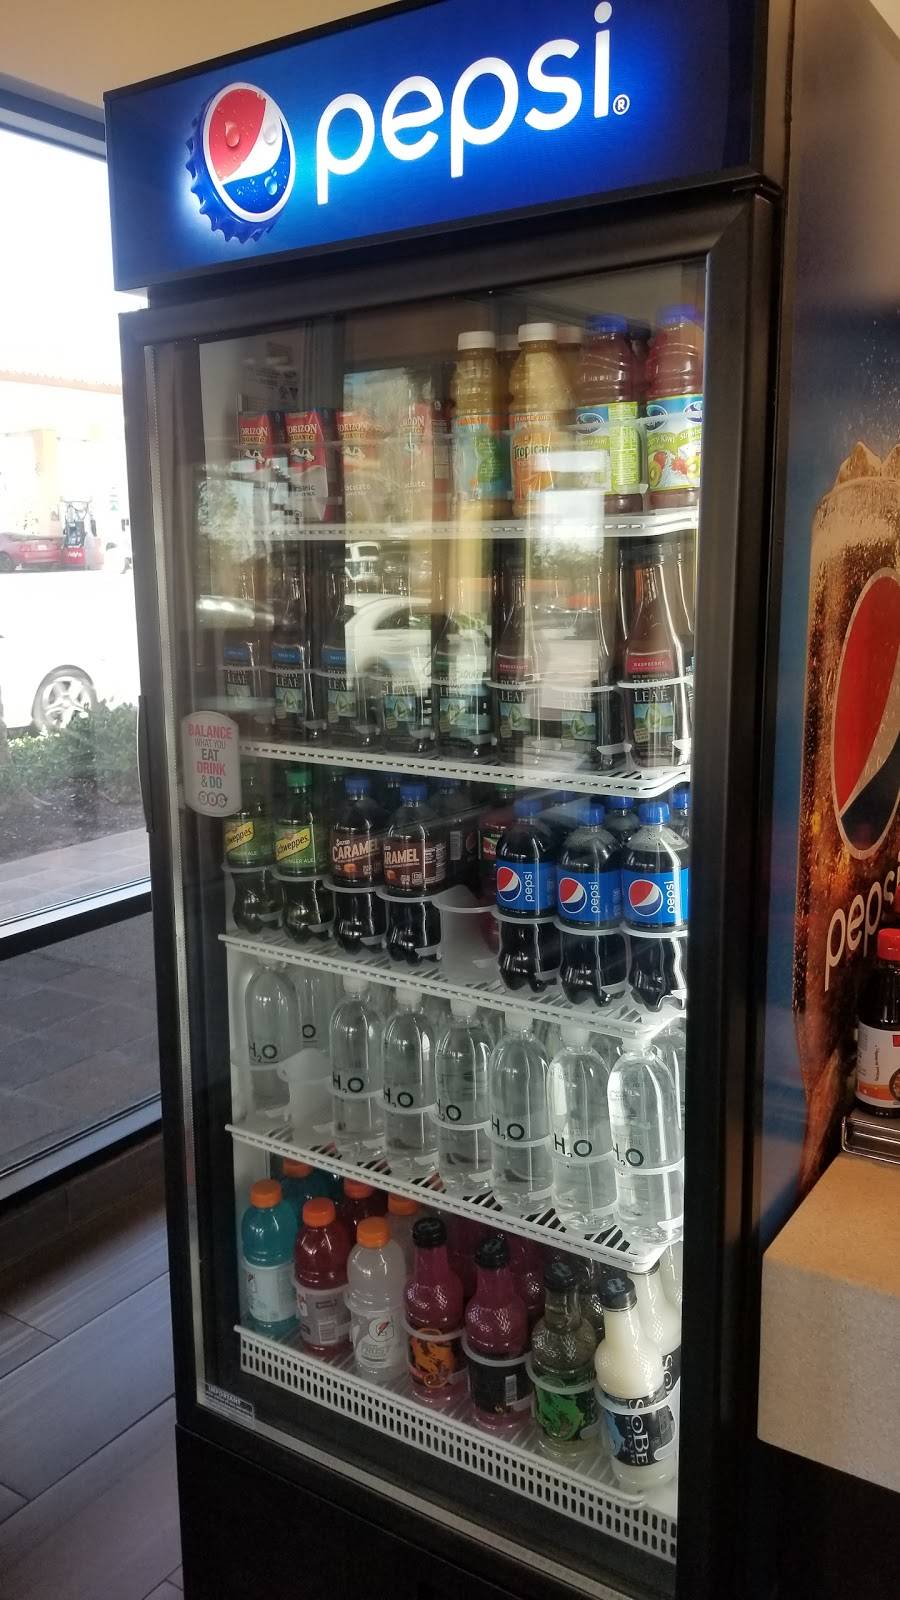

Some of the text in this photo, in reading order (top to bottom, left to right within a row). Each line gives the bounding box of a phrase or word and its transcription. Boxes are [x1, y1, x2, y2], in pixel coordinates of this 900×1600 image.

[316, 1, 612, 206] pepsi
[240, 426, 268, 437] ORIZON
[286, 423, 317, 434] ORIZON
[514, 444, 551, 460] Tropican
[276, 677, 299, 688] LEAF
[501, 691, 526, 702] LEAF
[634, 691, 668, 703] LEAF
[187, 723, 232, 740] BALANCE
[195, 737, 226, 750] WHAT YOU
[201, 748, 219, 762] EAT
[196, 761, 225, 777] DRINK
[201, 775, 222, 789] & DO
[332, 840, 378, 862] CARAMEL
[384, 848, 419, 866] ARAMEL
[523, 871, 535, 903] pepsi
[588, 880, 600, 914] pepsi
[664, 880, 677, 914] pepsi
[824, 848, 900, 991] peps
